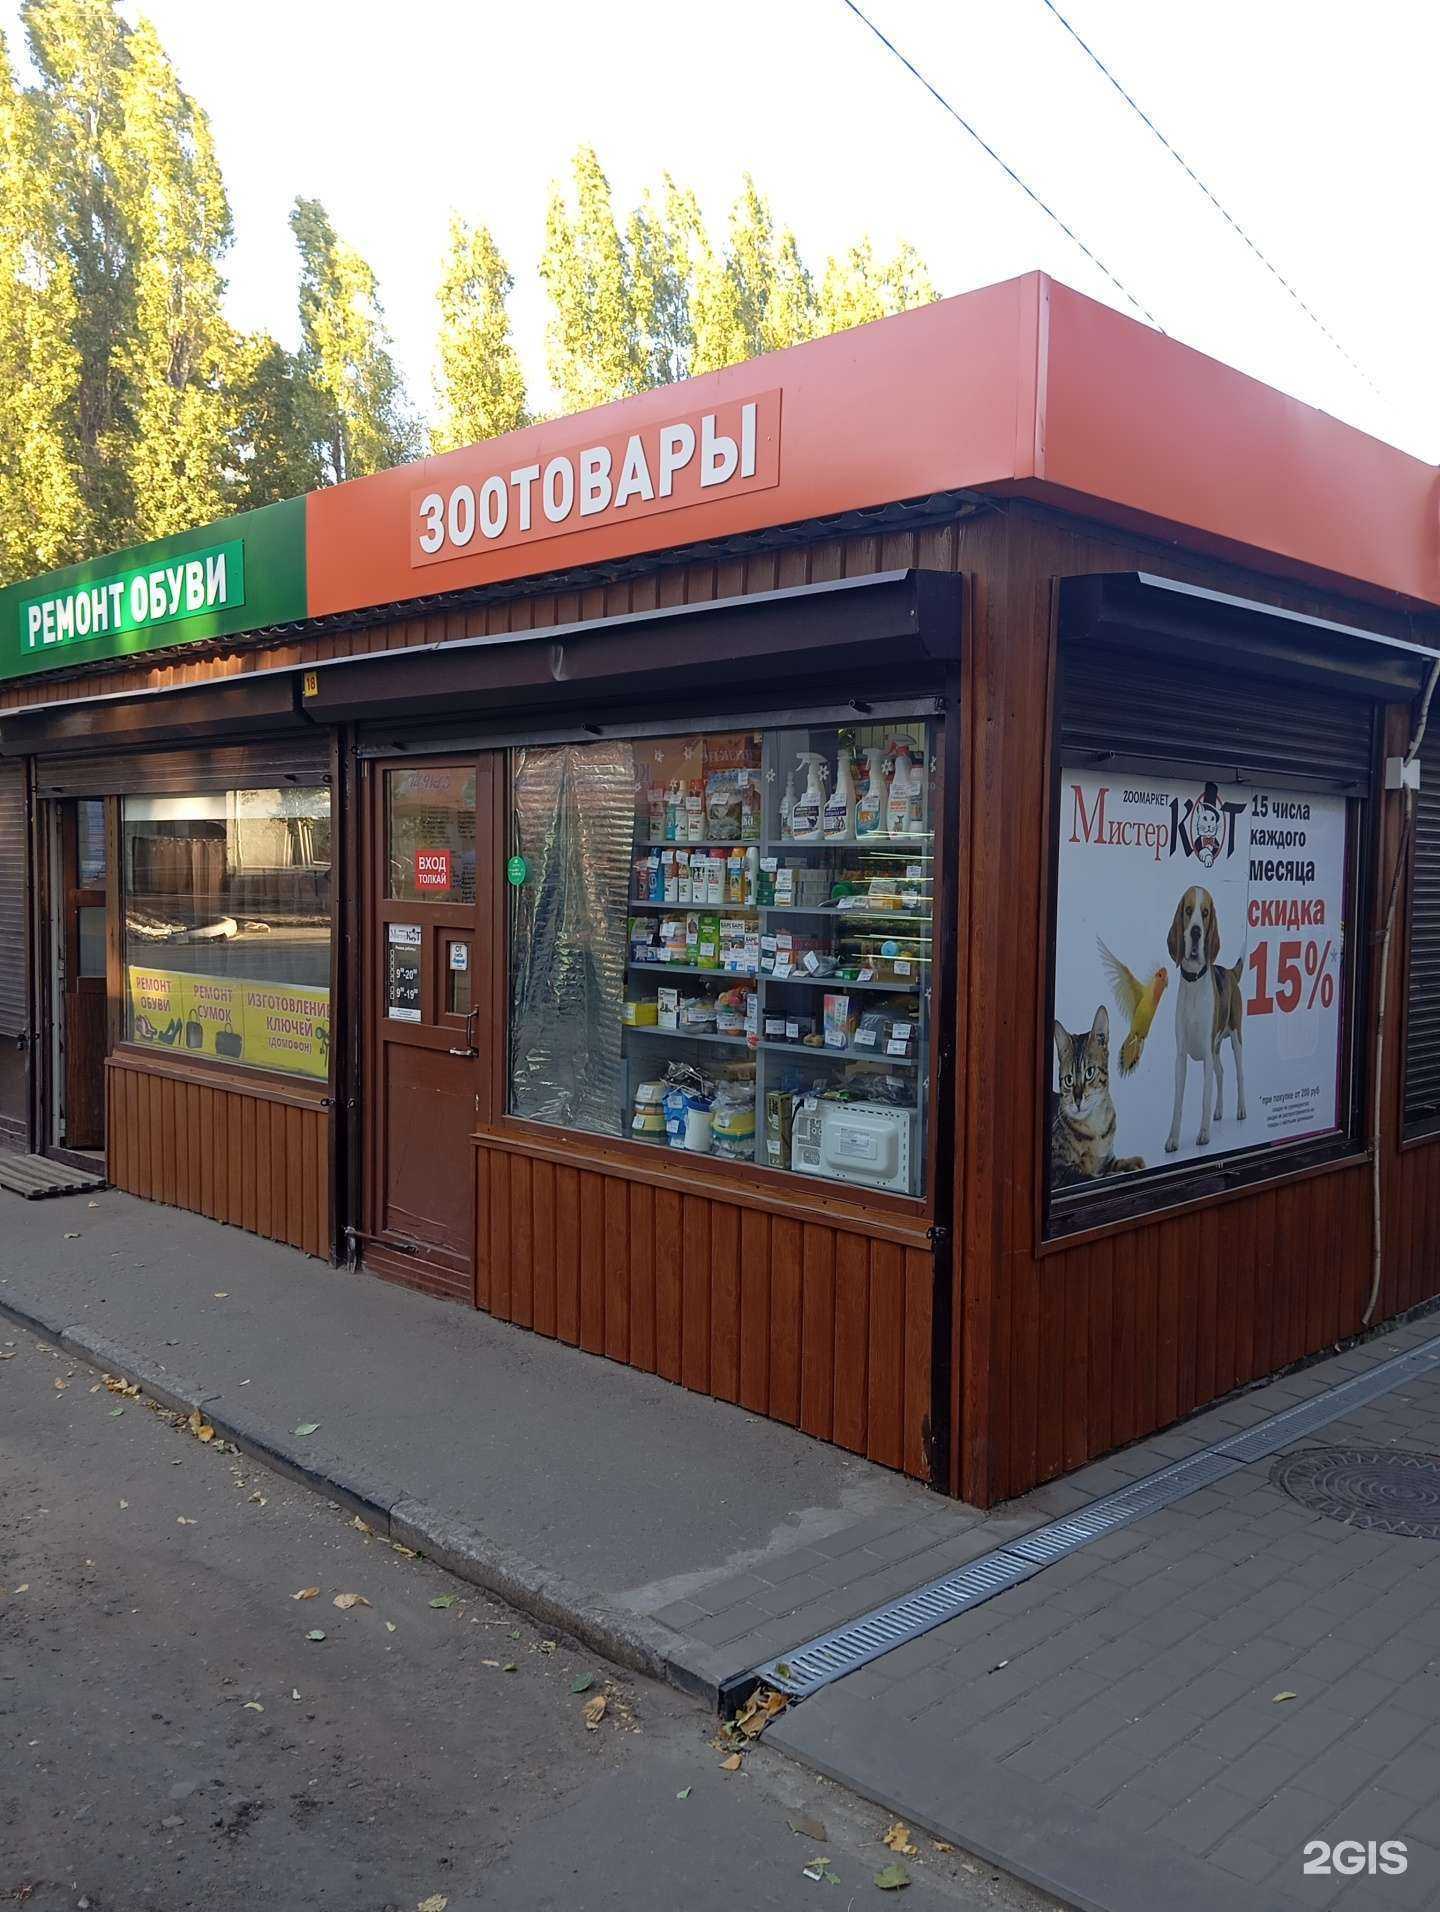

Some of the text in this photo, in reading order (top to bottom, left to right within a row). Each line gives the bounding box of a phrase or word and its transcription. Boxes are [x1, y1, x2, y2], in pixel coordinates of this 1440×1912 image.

[419, 403, 756, 554] ЗООТОВАРЫ
[28, 553, 227, 647] РЕМОНТ ОБУВИ
[307, 676, 315, 691] 18
[1251, 795, 1310, 821] 15 числа
[1069, 784, 1169, 861] Мистер
[1250, 827, 1306, 849] каждого
[418, 856, 446, 873] ВХОД
[1249, 859, 1315, 885] месяца
[418, 874, 447, 885] ТОЛКАЙ
[1248, 899, 1325, 931] скидка
[136, 976, 172, 993] РЕМОНТ
[193, 984, 232, 1003] РЕМОНТ
[140, 996, 171, 1012] ОБУВИ
[197, 1004, 232, 1023] СУМОК
[266, 1016, 313, 1037] КЛЮЧЕЙ
